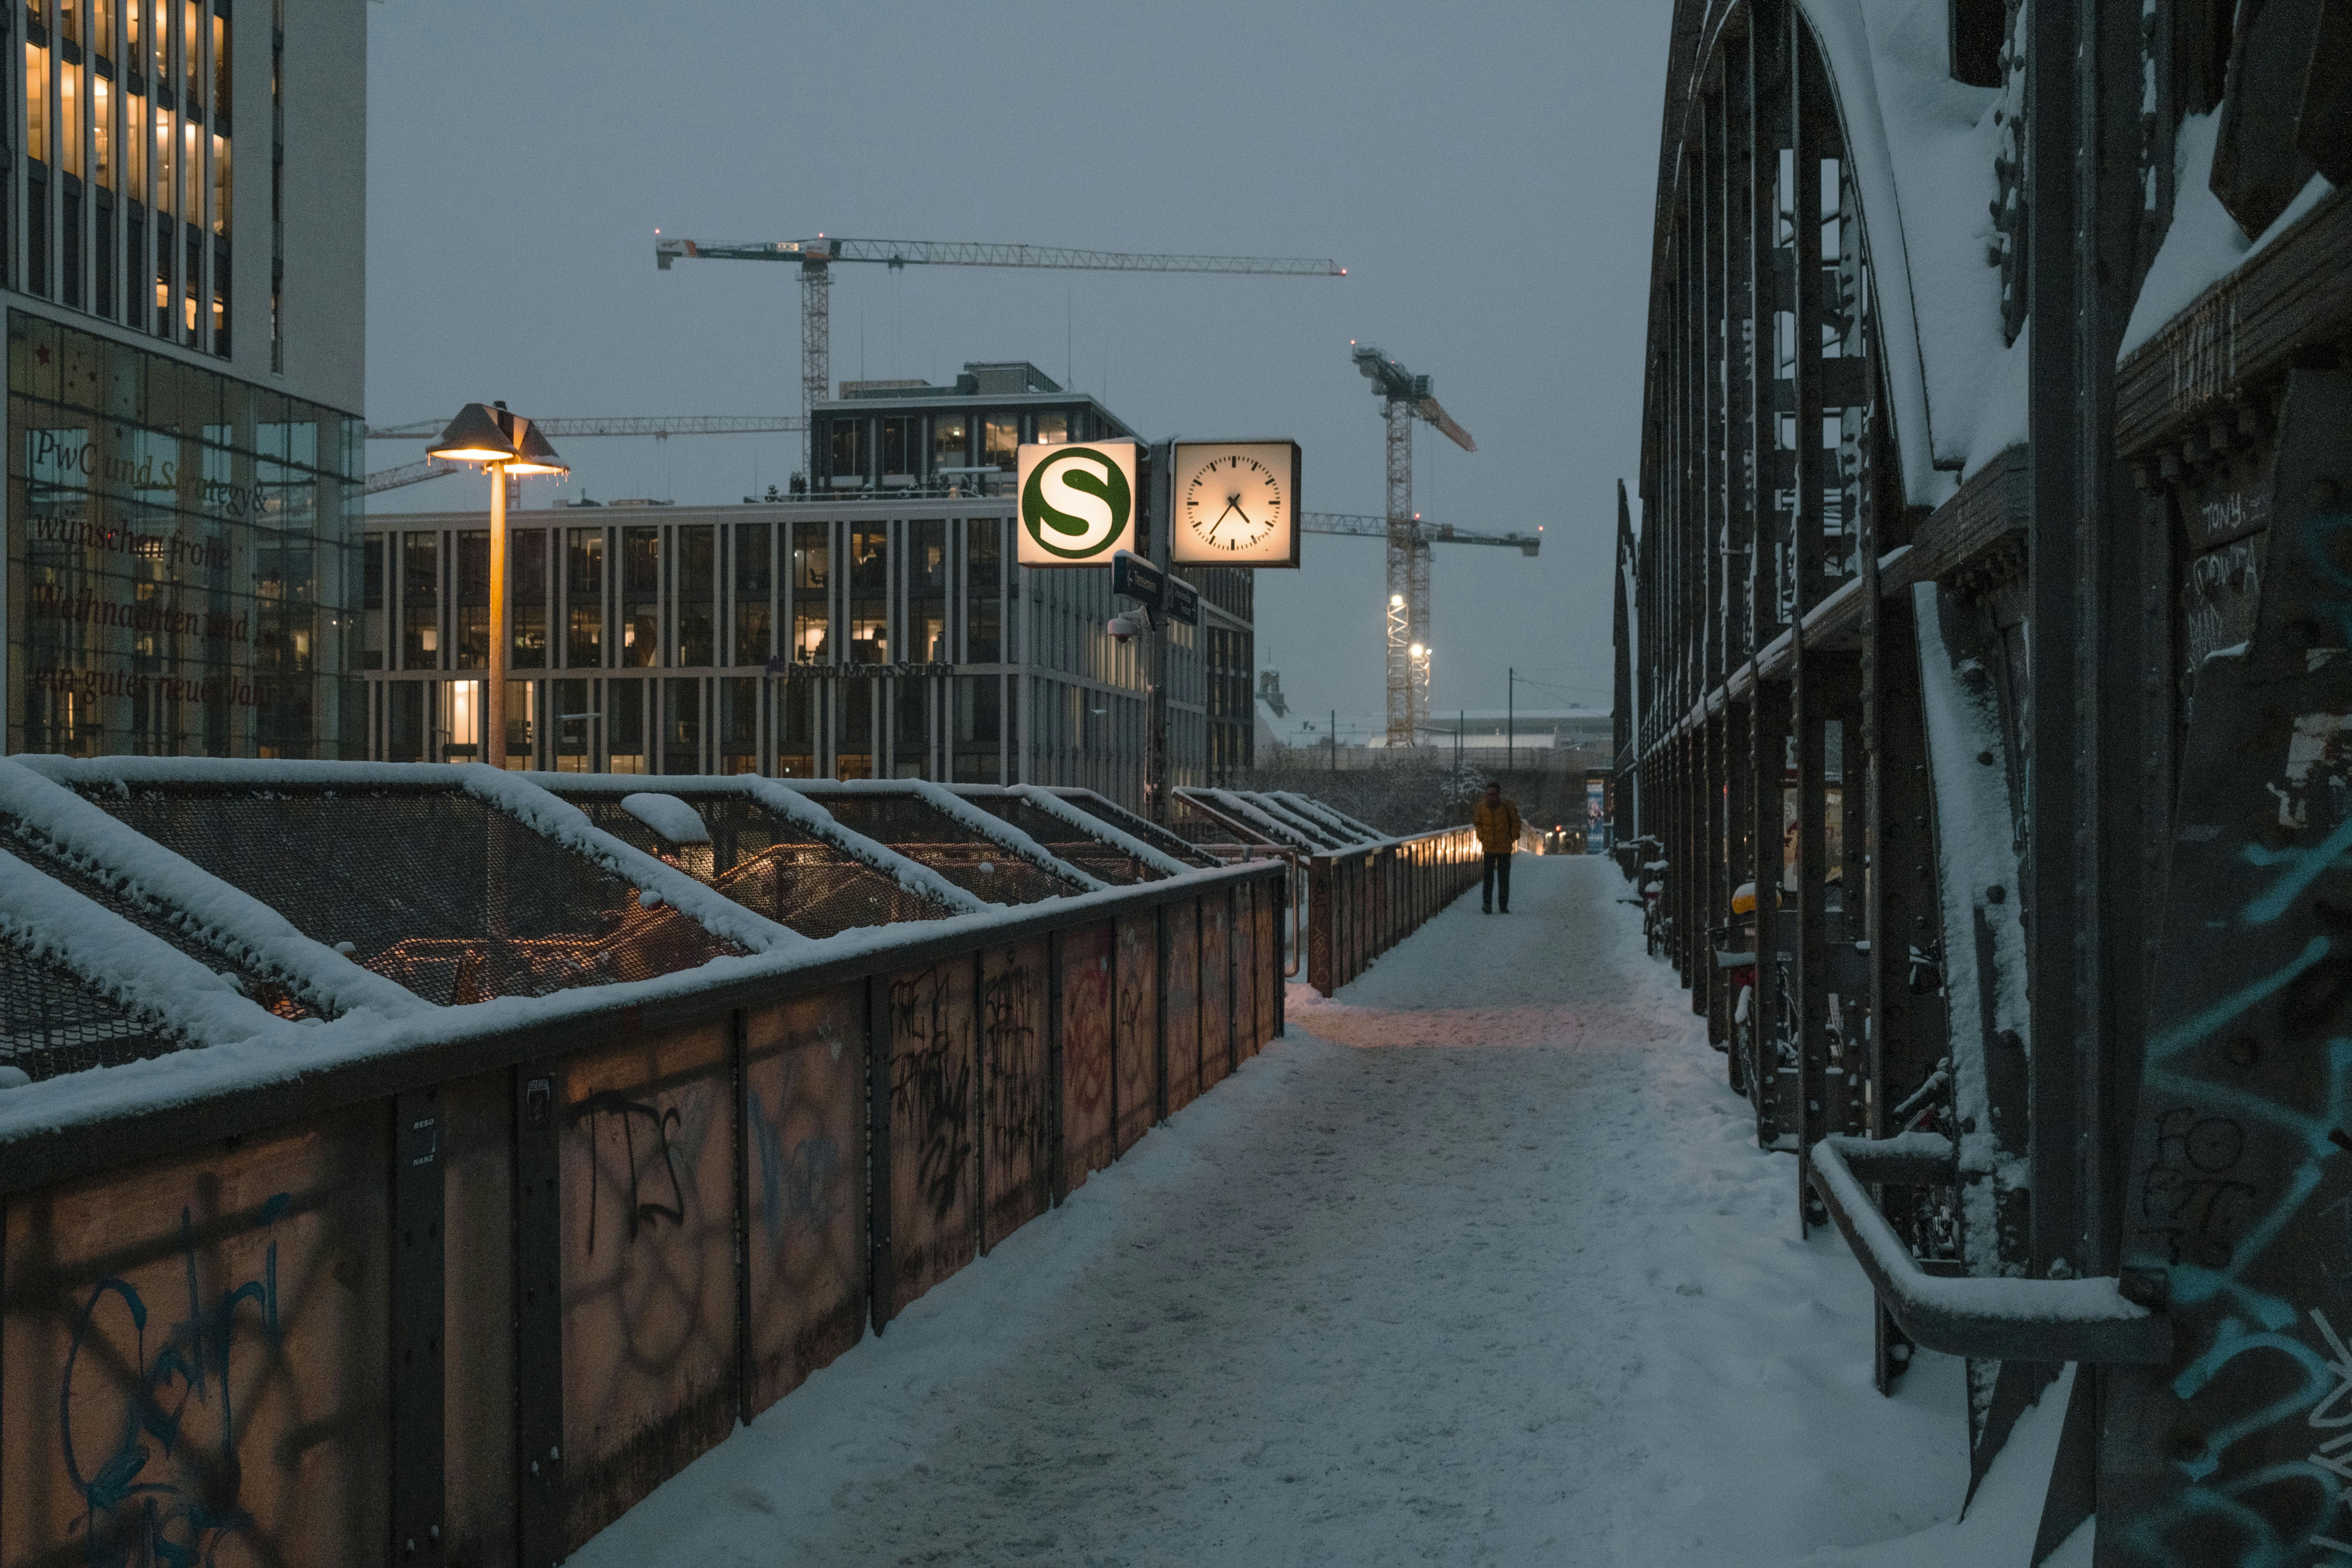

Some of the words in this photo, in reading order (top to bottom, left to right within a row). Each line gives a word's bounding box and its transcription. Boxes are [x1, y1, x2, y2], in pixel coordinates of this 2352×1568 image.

[35, 429, 98, 475] PwC
[103, 455, 153, 486] und
[1040, 456, 1113, 550] S
[844, 661, 894, 678] Myers
